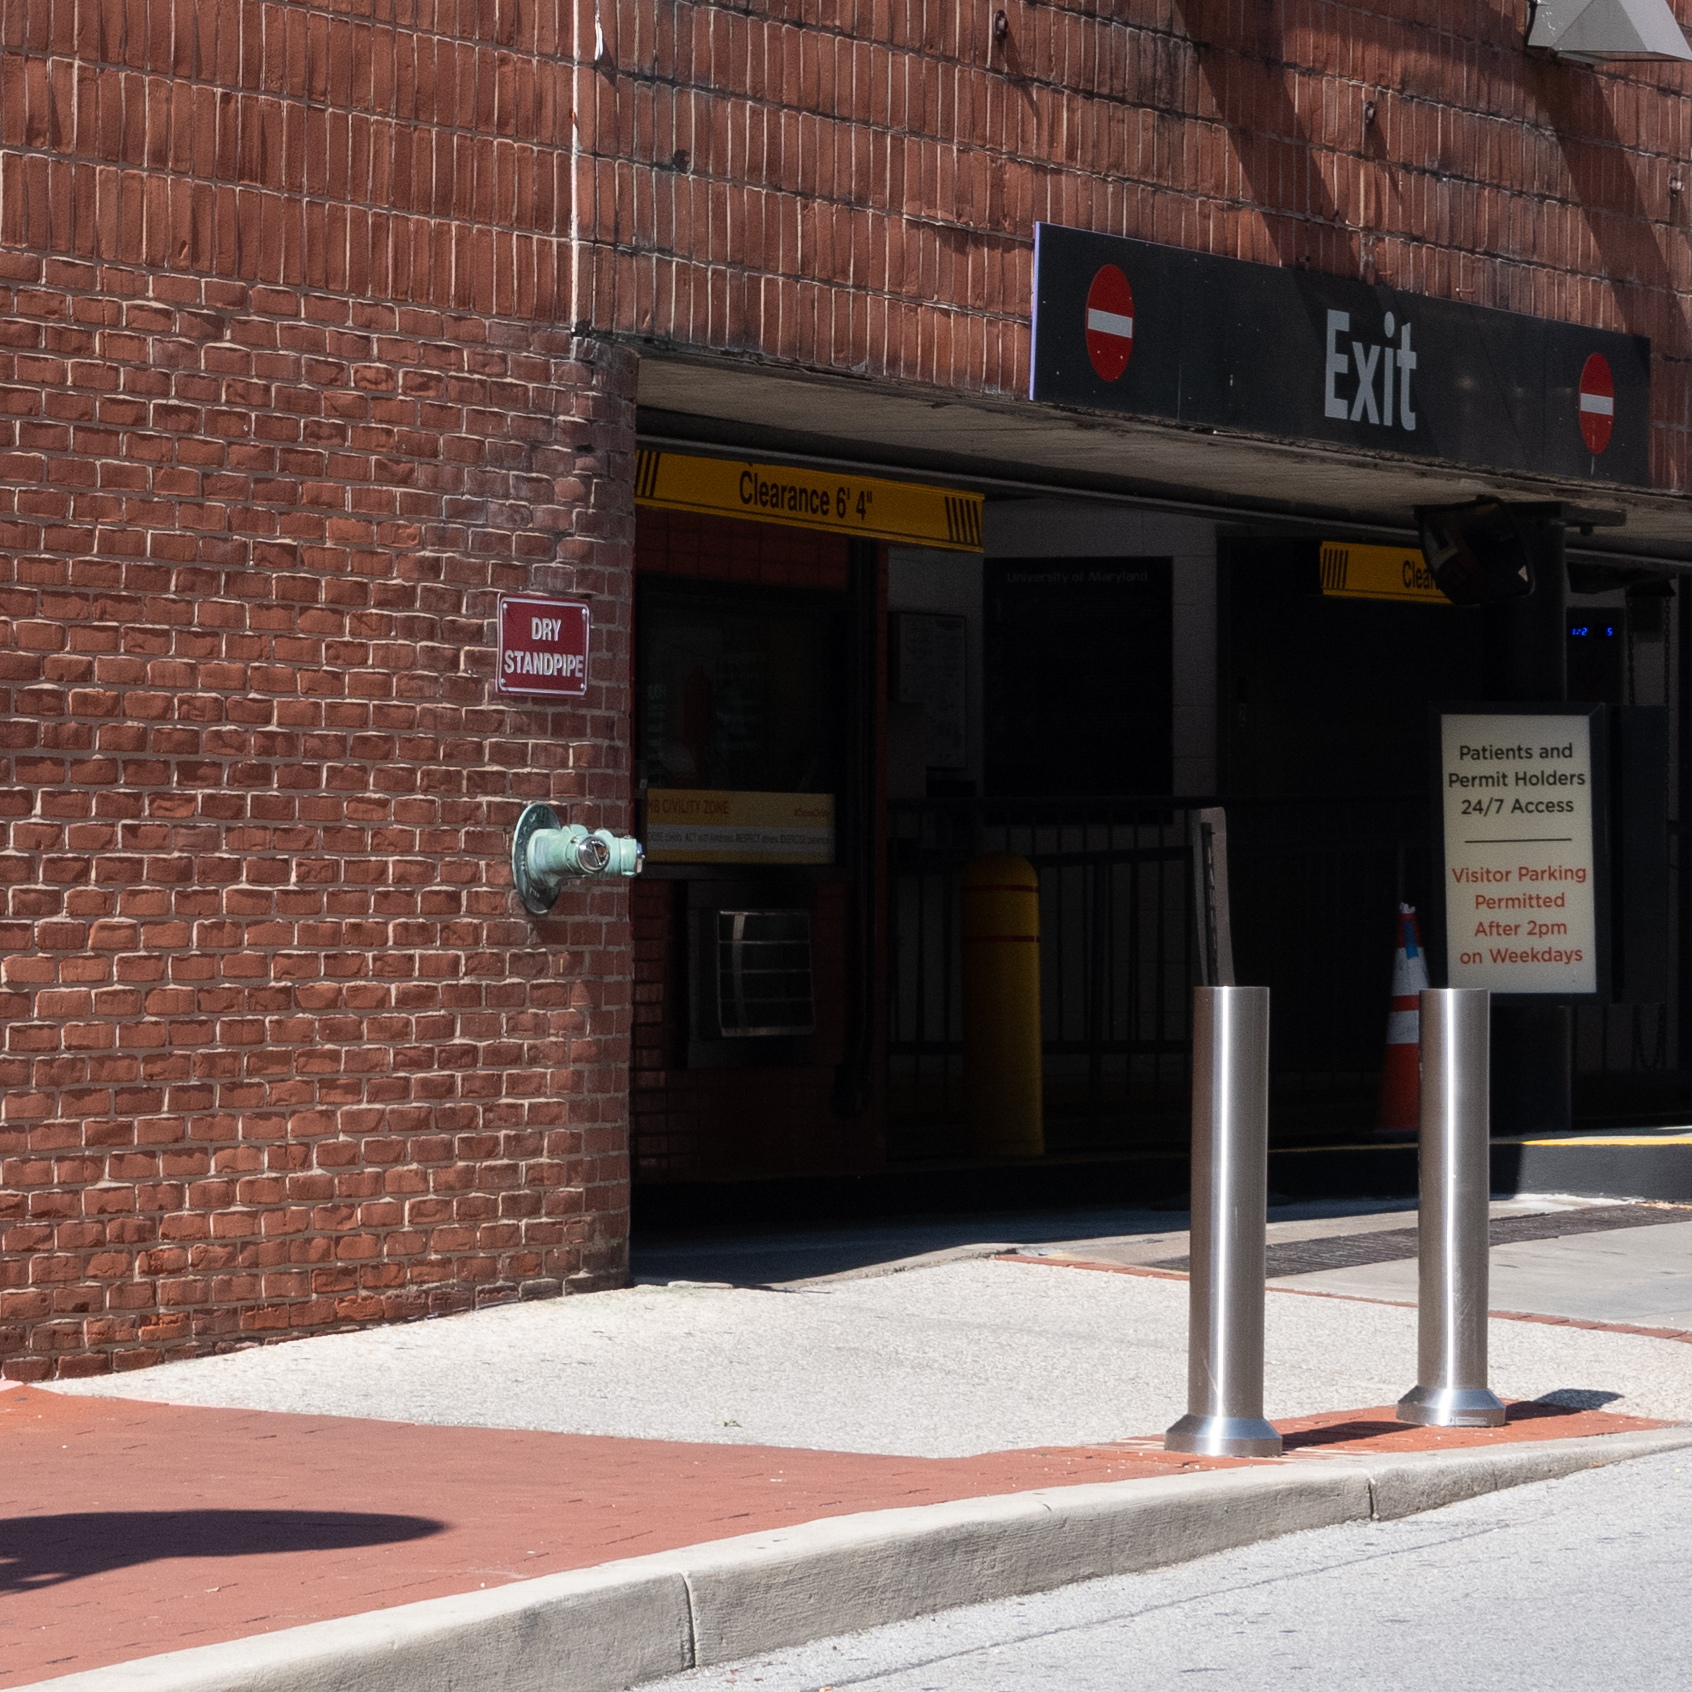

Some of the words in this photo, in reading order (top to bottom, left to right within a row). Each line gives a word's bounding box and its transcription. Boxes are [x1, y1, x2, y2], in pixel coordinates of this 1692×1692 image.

[1324, 309, 1417, 431] Exit
[739, 470, 830, 516] Clearance
[836, 487, 850, 519] 6'
[856, 490, 873, 521] 4"
[1007, 571, 1069, 584] University
[1072, 571, 1084, 582] of
[1089, 571, 1148, 584] Maryland
[1402, 560, 1439, 590] Clear
[531, 616, 562, 641] DRY
[504, 649, 584, 678] STANDPIPE
[1459, 745, 1533, 760] Patients
[1539, 743, 1573, 759] and
[1448, 772, 1508, 787] Permit
[1515, 770, 1585, 786] Holders
[663, 799, 701, 814] CIVILITY
[703, 800, 729, 815] ZONE
[1461, 797, 1504, 817] 24/7
[1511, 798, 1574, 814] Access
[1452, 867, 1512, 883] Visitor
[1518, 865, 1586, 884] Parking
[1475, 892, 1565, 909] Permitted
[1475, 921, 1520, 937] After
[1527, 920, 1567, 938] 2pm
[1460, 951, 1482, 964] on
[1489, 947, 1583, 965] Weekdays
